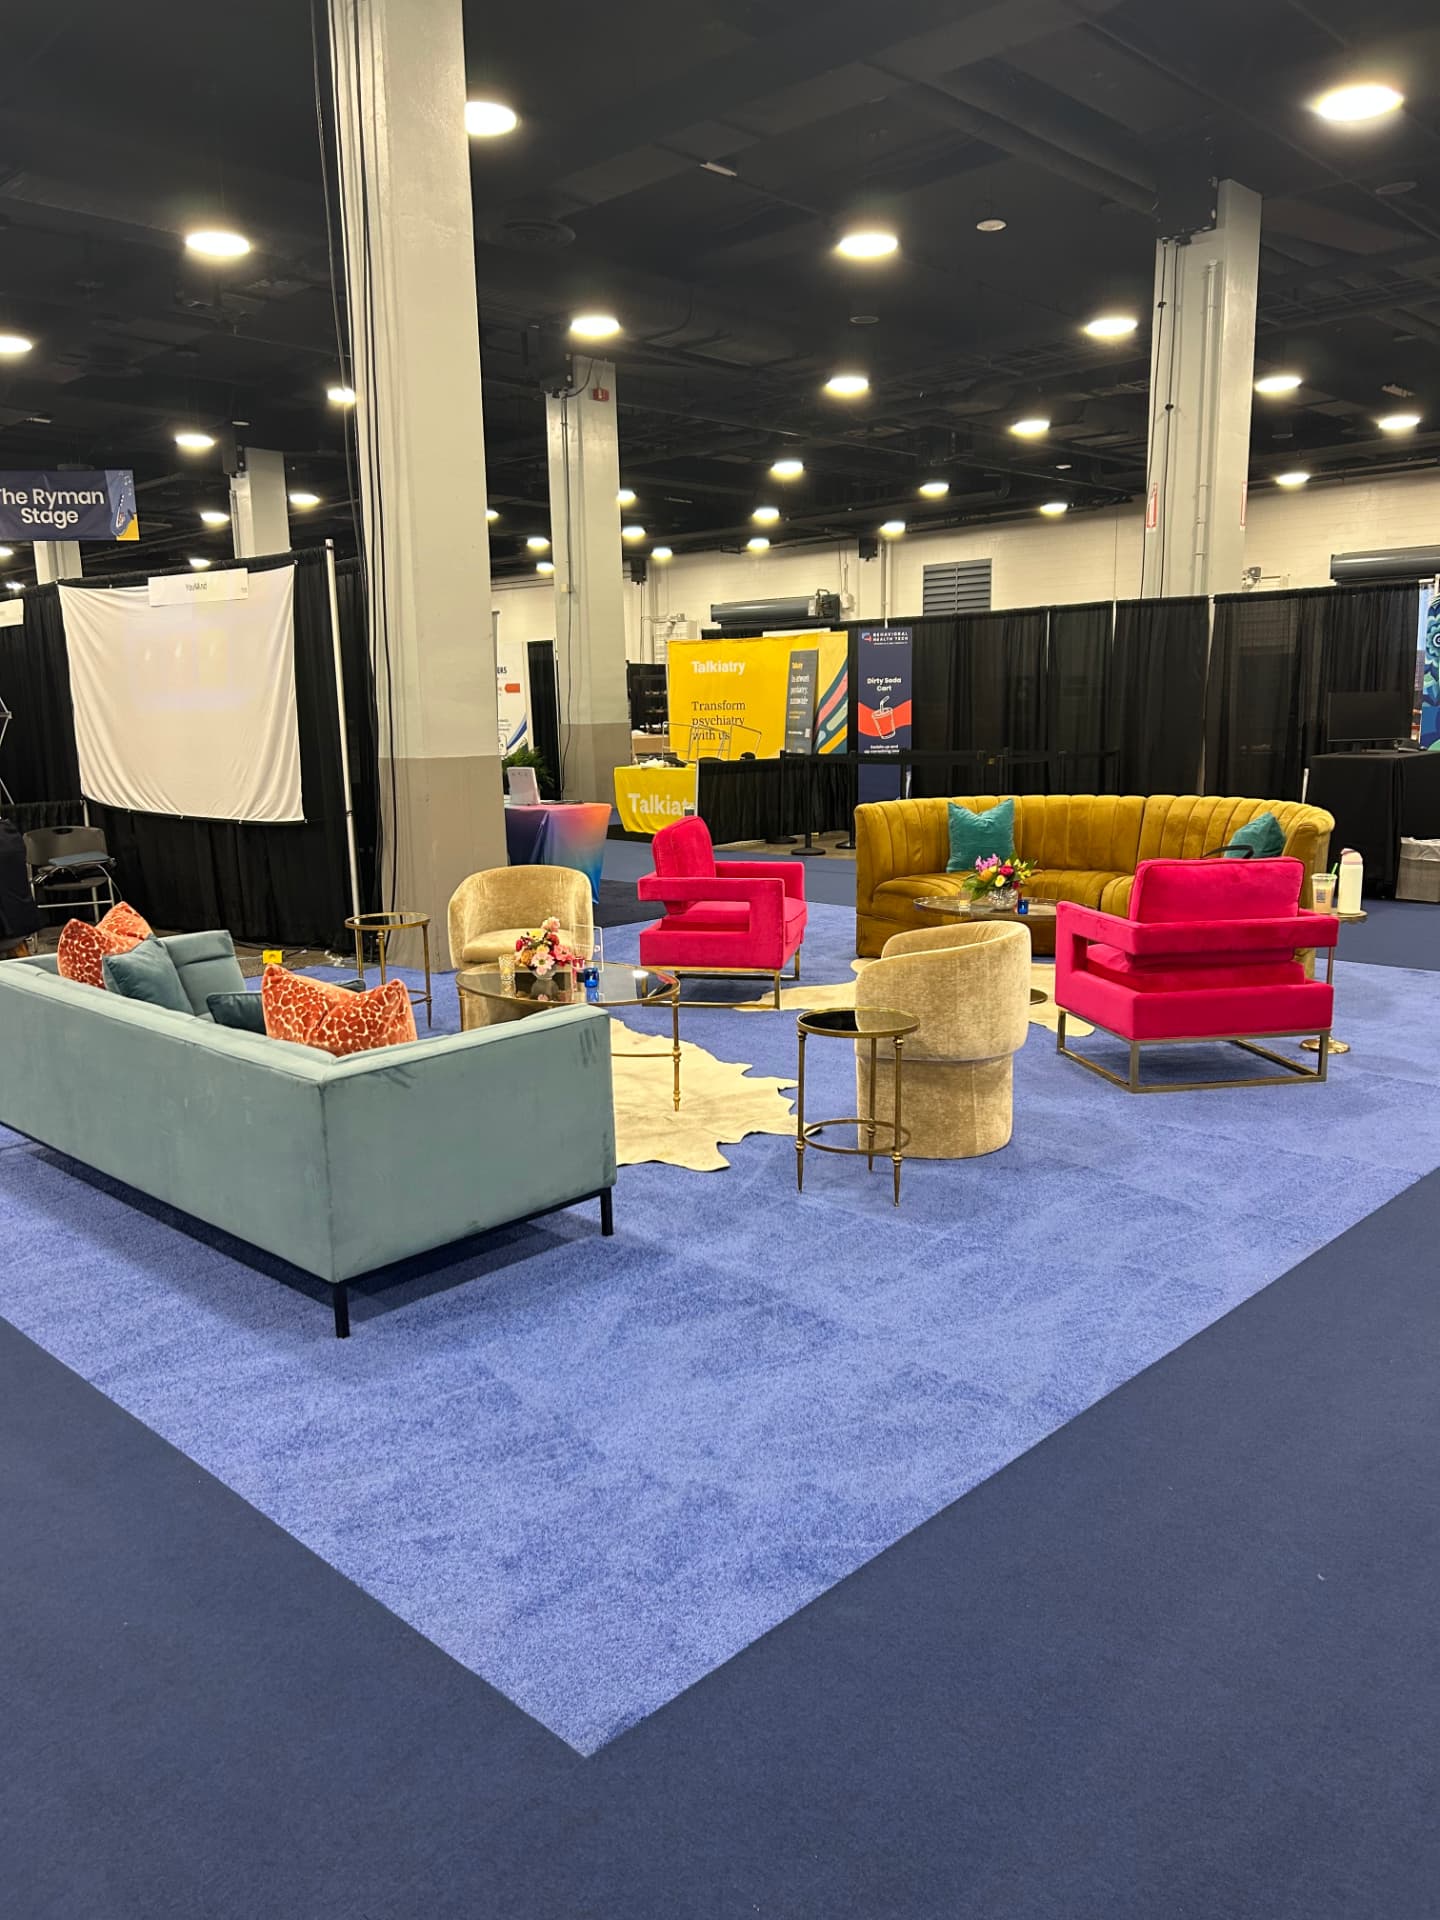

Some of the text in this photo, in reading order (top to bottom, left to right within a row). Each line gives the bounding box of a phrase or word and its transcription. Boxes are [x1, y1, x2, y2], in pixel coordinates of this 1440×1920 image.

[0, 488, 105, 510] he Ryman
[21, 507, 79, 529] Stage
[691, 660, 746, 675] Talkiatry
[867, 677, 883, 685] Dirty
[691, 700, 746, 711] Transform
[692, 715, 745, 727] psychiatry
[692, 729, 716, 741] with
